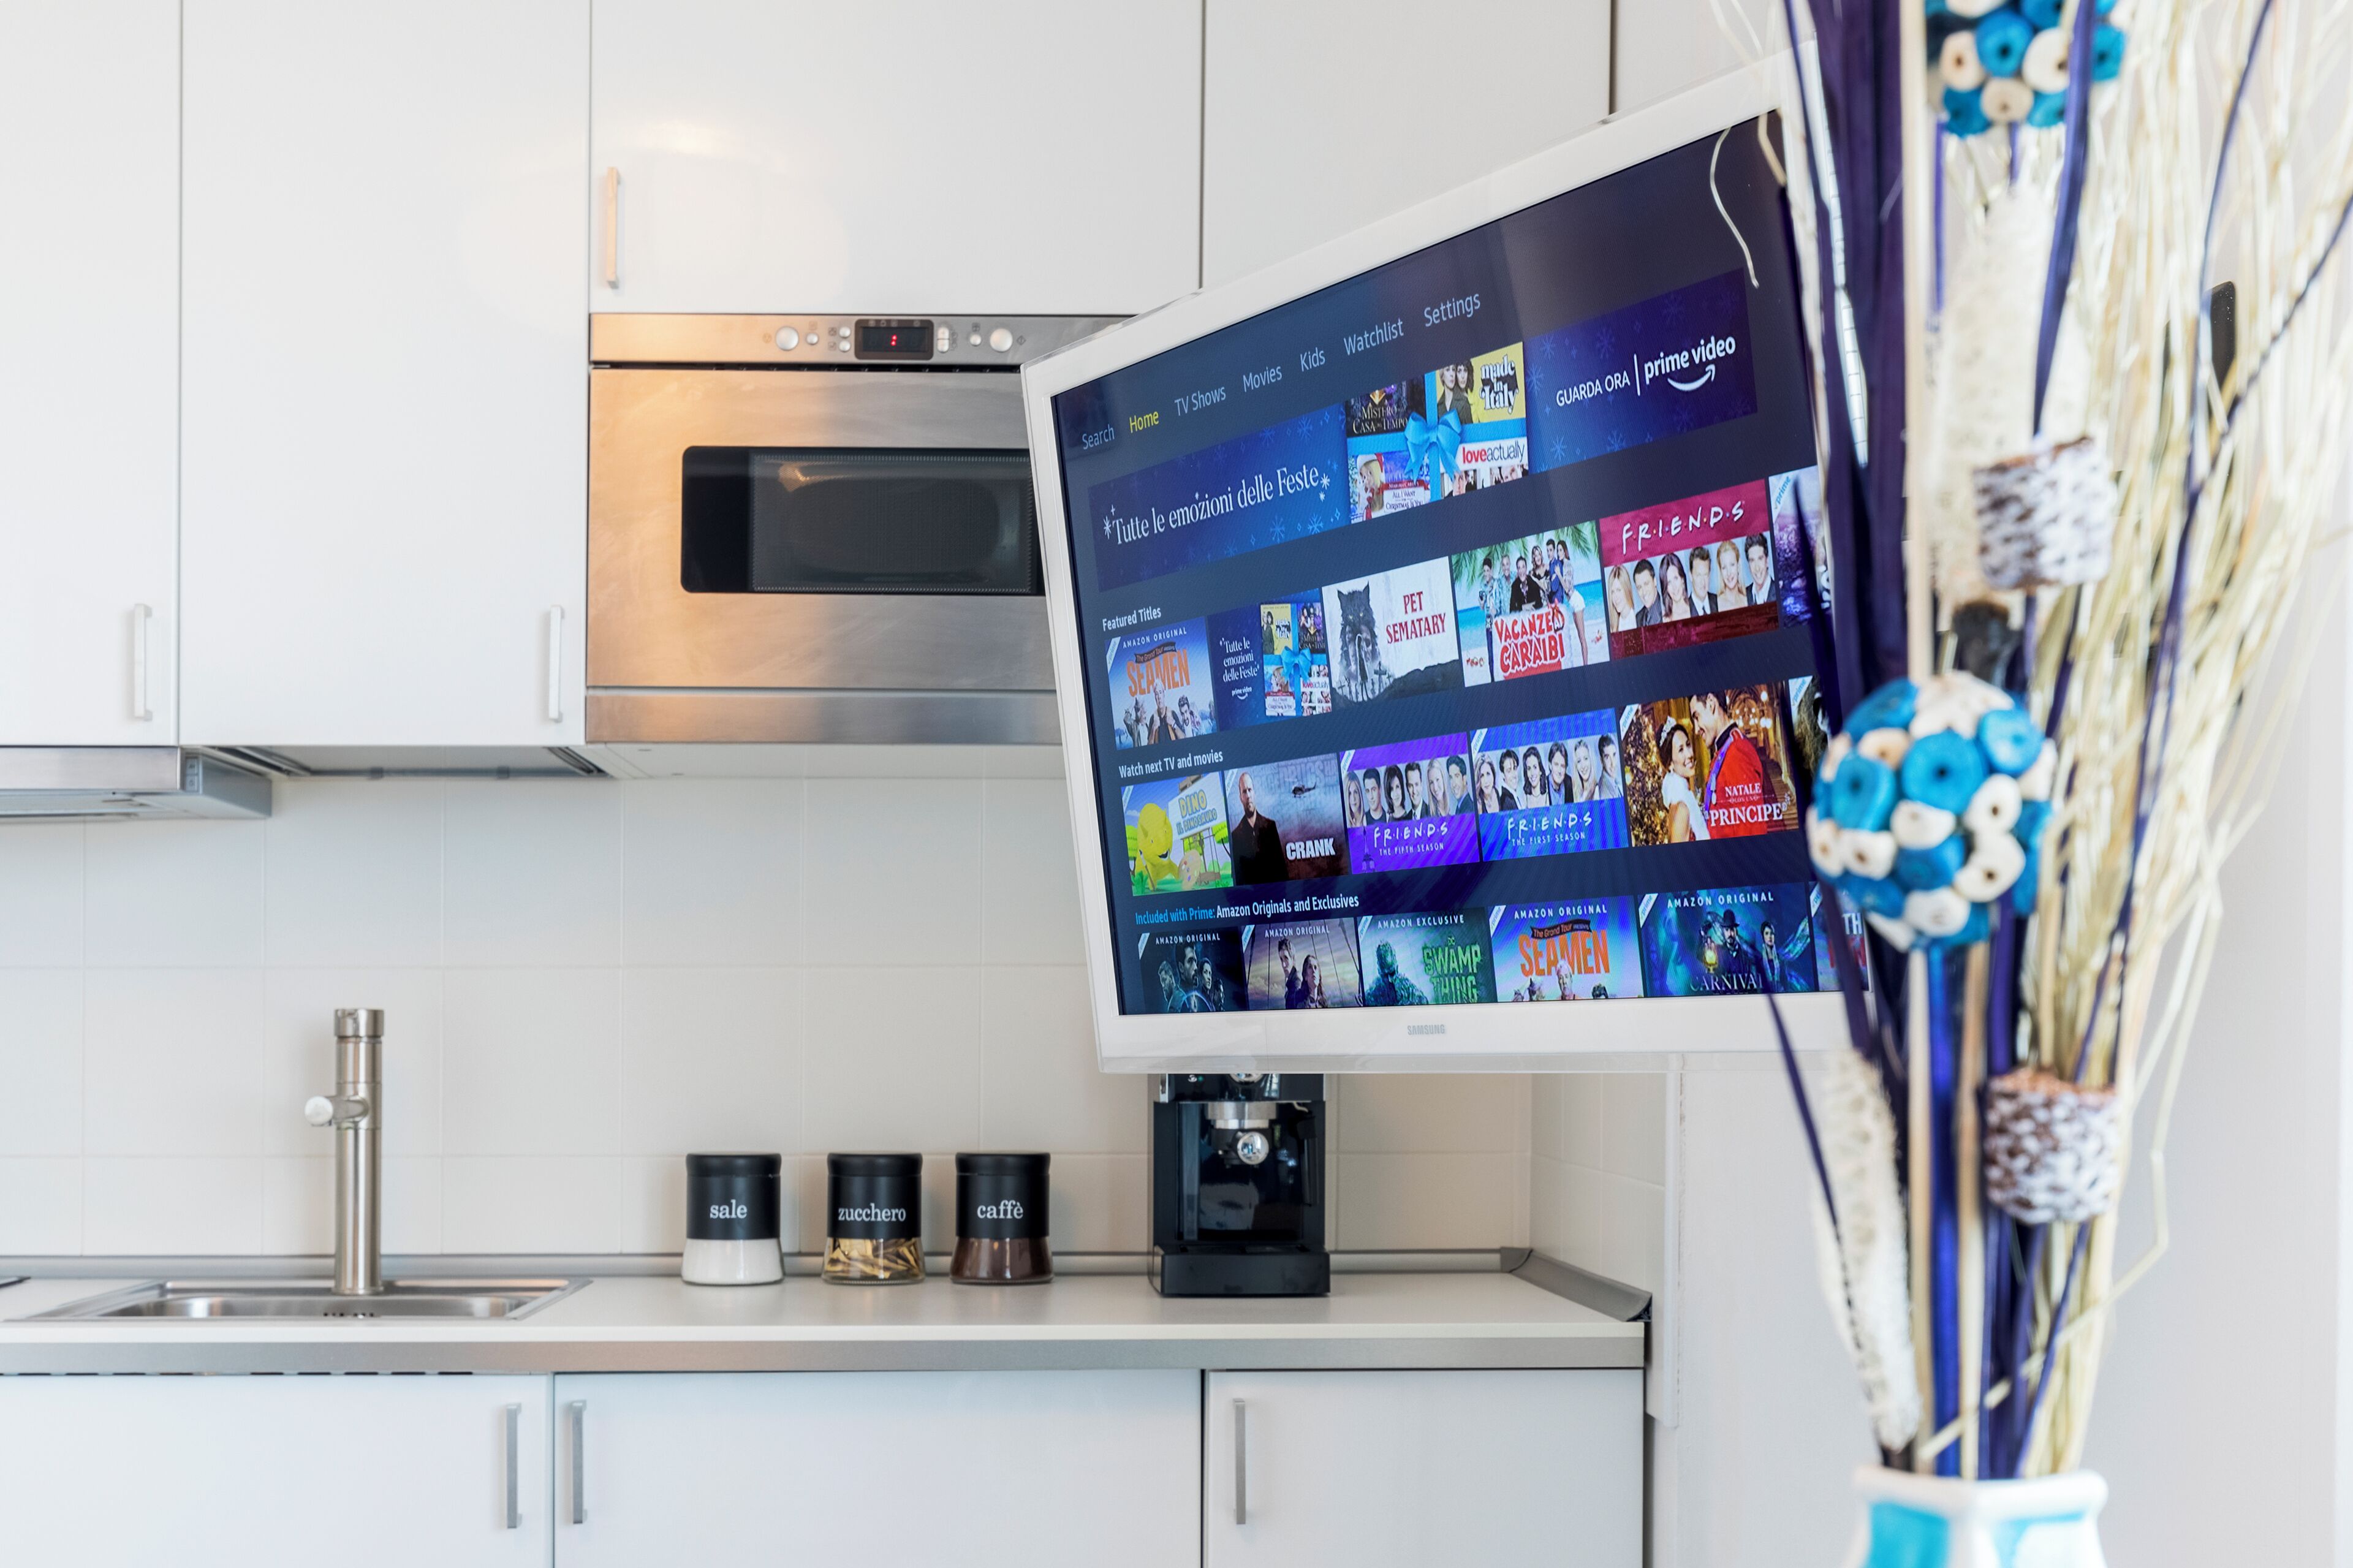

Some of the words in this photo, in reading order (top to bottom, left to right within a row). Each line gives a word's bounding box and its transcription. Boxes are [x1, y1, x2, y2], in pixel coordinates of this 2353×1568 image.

[1424, 293, 1480, 327] Settings
[1344, 318, 1404, 355] Watchlist
[1300, 347, 1325, 372] Kids
[1480, 354, 1515, 382] made
[1644, 350, 1690, 384] prime
[1691, 336, 1736, 365] video
[1243, 365, 1283, 392] Movies
[1493, 379, 1503, 392] in
[1556, 381, 1602, 407] GUARDA
[1605, 371, 1630, 394] ORA
[1175, 396, 1189, 416] TV
[1192, 386, 1226, 412] Shows
[1479, 383, 1519, 414] Italy
[1129, 411, 1159, 433] Home
[1082, 424, 1115, 450] Search
[1776, 475, 1791, 504] prime
[1112, 515, 1150, 545] Tutte
[1152, 507, 1165, 534] le
[1169, 485, 1233, 529] emozioni
[1237, 475, 1273, 508] delle
[1276, 466, 1319, 496] Feste
[1403, 591, 1423, 615] PET
[1102, 612, 1137, 632] Featured
[1138, 607, 1161, 623] Titles
[1386, 613, 1446, 645] SEMATARY
[1495, 612, 1553, 643] VACANZE
[1123, 635, 1150, 649] AMAZON
[1153, 627, 1187, 642] ORIGINAL
[1243, 637, 1250, 649] le
[1224, 650, 1254, 667] emozioni
[1500, 633, 1565, 673] CARAIBI
[1126, 648, 1190, 697] SEAMEN
[1223, 667, 1238, 683] delle
[1119, 763, 1143, 778] Watch
[1145, 760, 1162, 774] next
[1164, 757, 1175, 771] TV
[1177, 755, 1192, 769] and
[1194, 749, 1223, 767] movies
[1725, 782, 1762, 797] NATALE
[1178, 789, 1207, 819] DINO
[1710, 803, 1783, 827] PRINCIPE
[1176, 822, 1184, 835] IL
[1183, 808, 1218, 832] DINOSAURO
[1286, 838, 1335, 860] CRANK
[1395, 846, 1414, 854] FIFTH
[1417, 843, 1444, 852] SEASON
[1512, 838, 1525, 847] THE
[1530, 835, 1550, 845] FIRST
[1555, 831, 1585, 843] SEASON
[1135, 909, 1169, 925] Included
[1170, 908, 1188, 922] with
[1189, 906, 1216, 921] Prime:
[1216, 903, 1251, 918] Amazon
[1252, 899, 1292, 918] Originals
[1294, 898, 1310, 912] and
[1312, 893, 1359, 911] Exclusives
[1514, 908, 1553, 920] AMAZON
[1559, 904, 1607, 917] ORIGINAL
[1667, 896, 1713, 909] AMAZON
[1718, 891, 1774, 905] ORIGINAL
[1265, 928, 1294, 938] AMAZON
[1295, 925, 1330, 936] ORIGINAL
[1377, 917, 1412, 930] AMAZON
[1417, 914, 1465, 926] EXCLUSIVE
[1533, 929, 1544, 938] The
[1544, 926, 1560, 937] Grand
[1561, 923, 1573, 933] Tour
[1156, 936, 1183, 945] AMAZON
[1186, 933, 1221, 942] ORIGINAL
[1423, 944, 1481, 975] SWAMP
[1518, 928, 1610, 979] SEAMEN
[1430, 975, 1477, 1004] THING
[1408, 1024, 1445, 1036] SAMSUNG
[710, 1200, 747, 1219] sale
[838, 1203, 906, 1222] zucchero
[977, 1200, 1023, 1219] caffè
